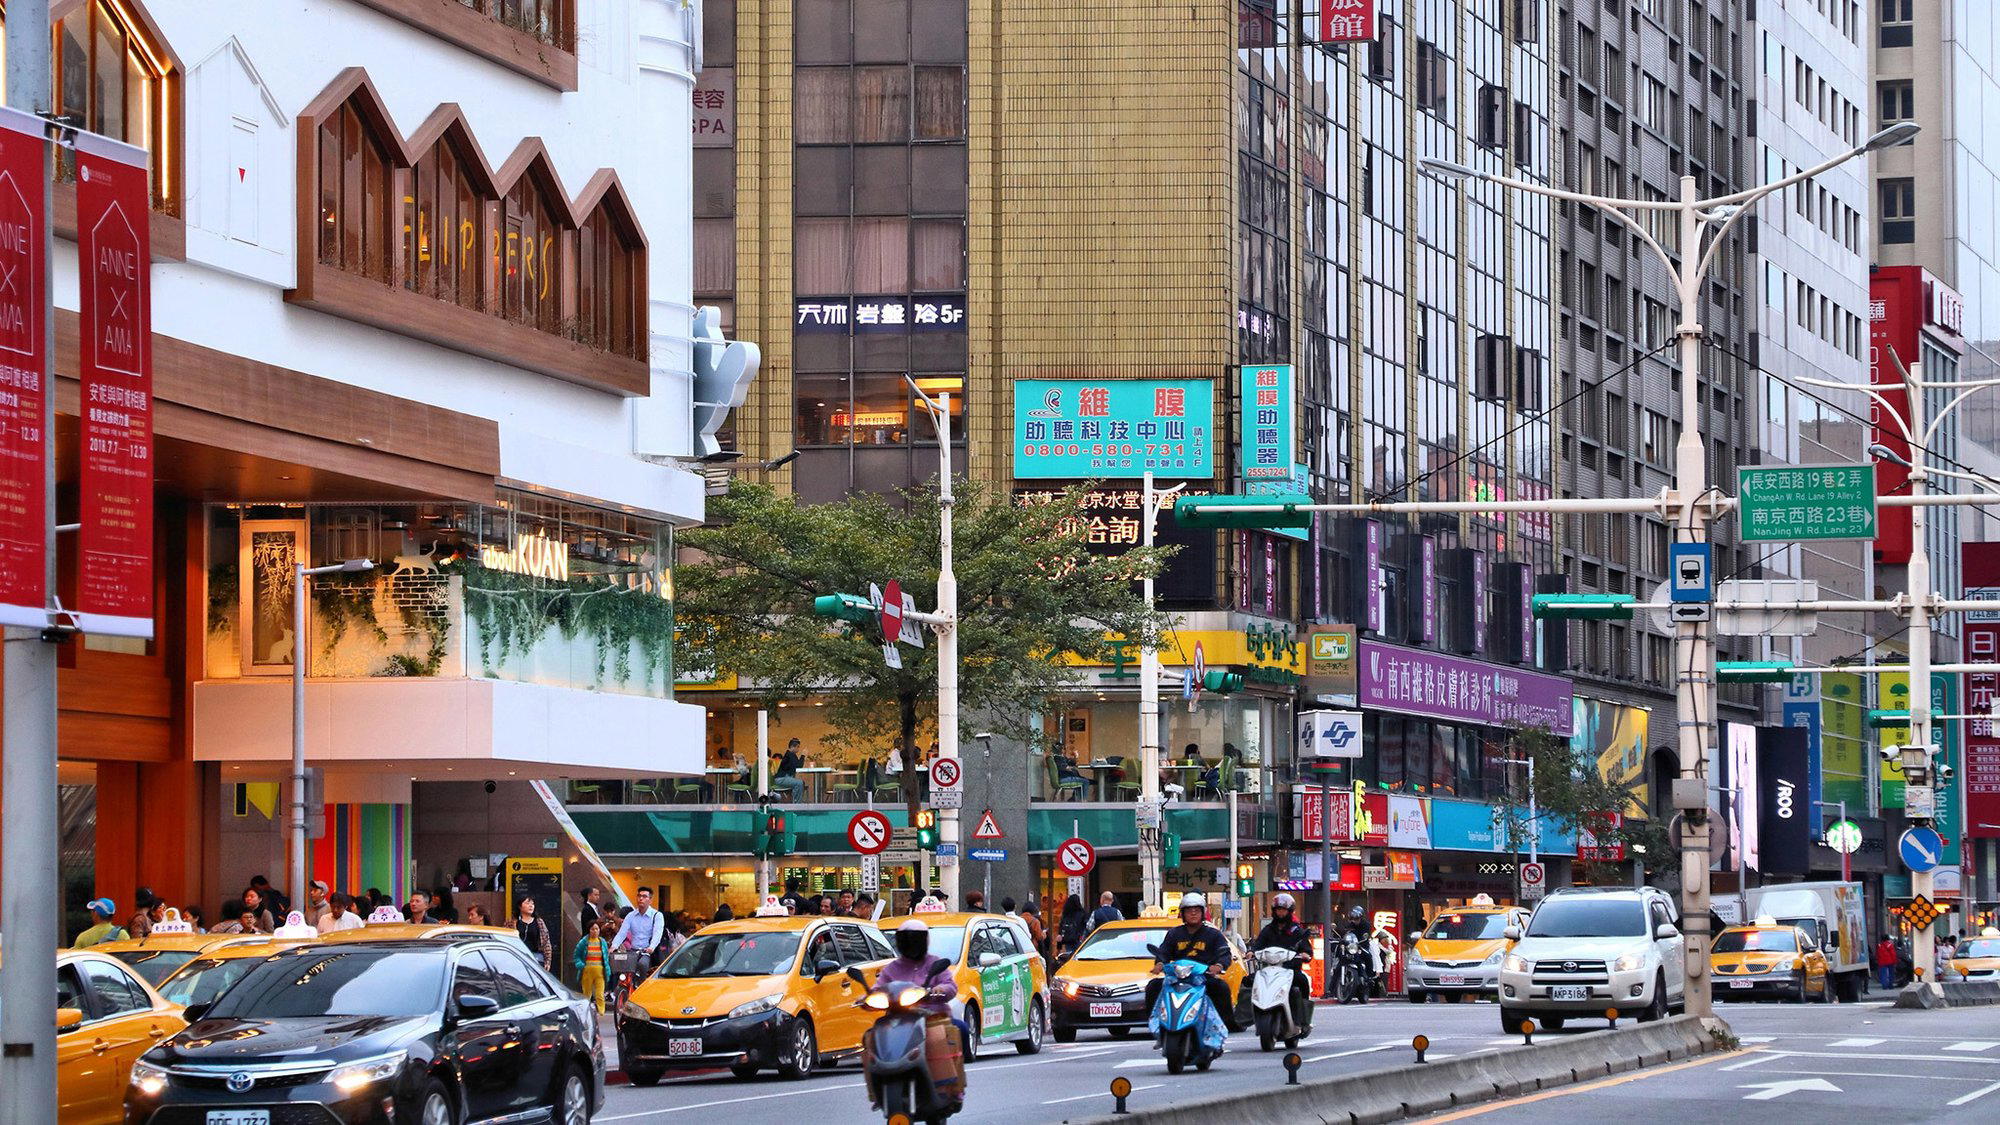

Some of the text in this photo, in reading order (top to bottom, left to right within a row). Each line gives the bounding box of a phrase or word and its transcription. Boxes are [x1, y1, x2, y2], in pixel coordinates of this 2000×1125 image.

[692, 89, 725, 110] 美容
[0, 227, 27, 255] NNE
[100, 246, 135, 280] ANNE
[0, 302, 24, 334] MA
[104, 325, 133, 356] AMA
[1078, 387, 1185, 417] 維膜
[1257, 370, 1278, 464] 維膜助聽器
[1024, 420, 1186, 441] 助聽科技中心
[1024, 444, 1185, 456] 0800-580-731
[1753, 493, 1784, 503] ChangAn
[1808, 492, 1825, 501] Lane
[1827, 492, 1835, 500] 19
[1836, 491, 1854, 501] Alley
[1856, 491, 1862, 500] 2
[1752, 506, 1864, 525] 南京西路23巷
[1753, 527, 1791, 537] NanJing
[1824, 525, 1846, 534] Lane
[1849, 524, 1862, 534] 23
[482, 546, 517, 572] about
[1332, 646, 1348, 654] TMK
[1387, 656, 1492, 714] 南西維格皮膚科診所
